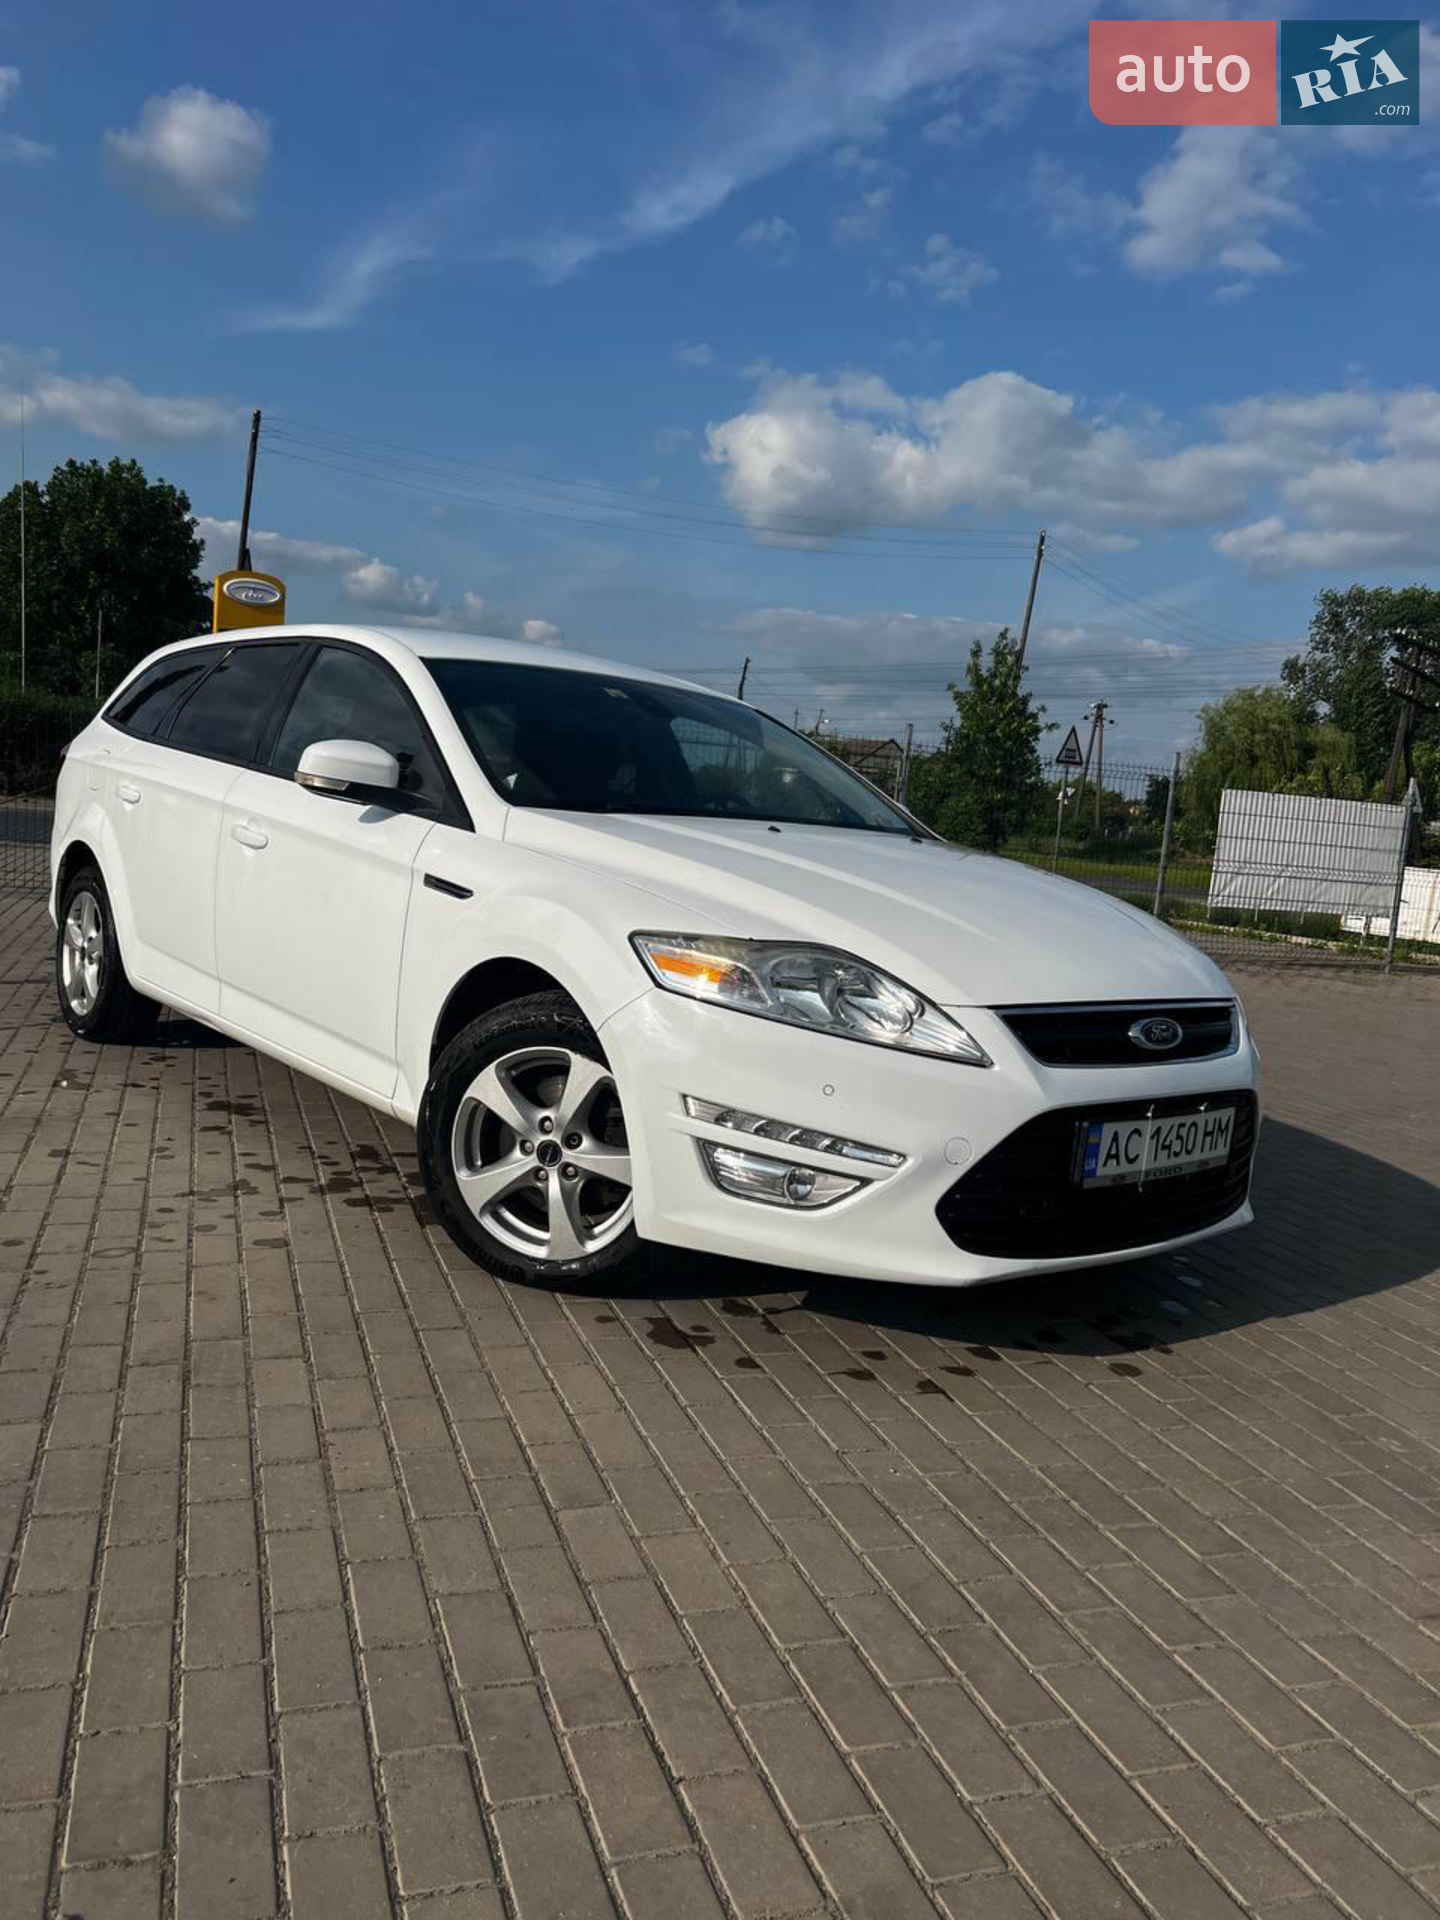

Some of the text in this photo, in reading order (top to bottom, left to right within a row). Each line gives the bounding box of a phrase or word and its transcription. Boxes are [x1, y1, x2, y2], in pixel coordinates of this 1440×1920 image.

[1102, 1115, 1231, 1168] AC 1450 HM
